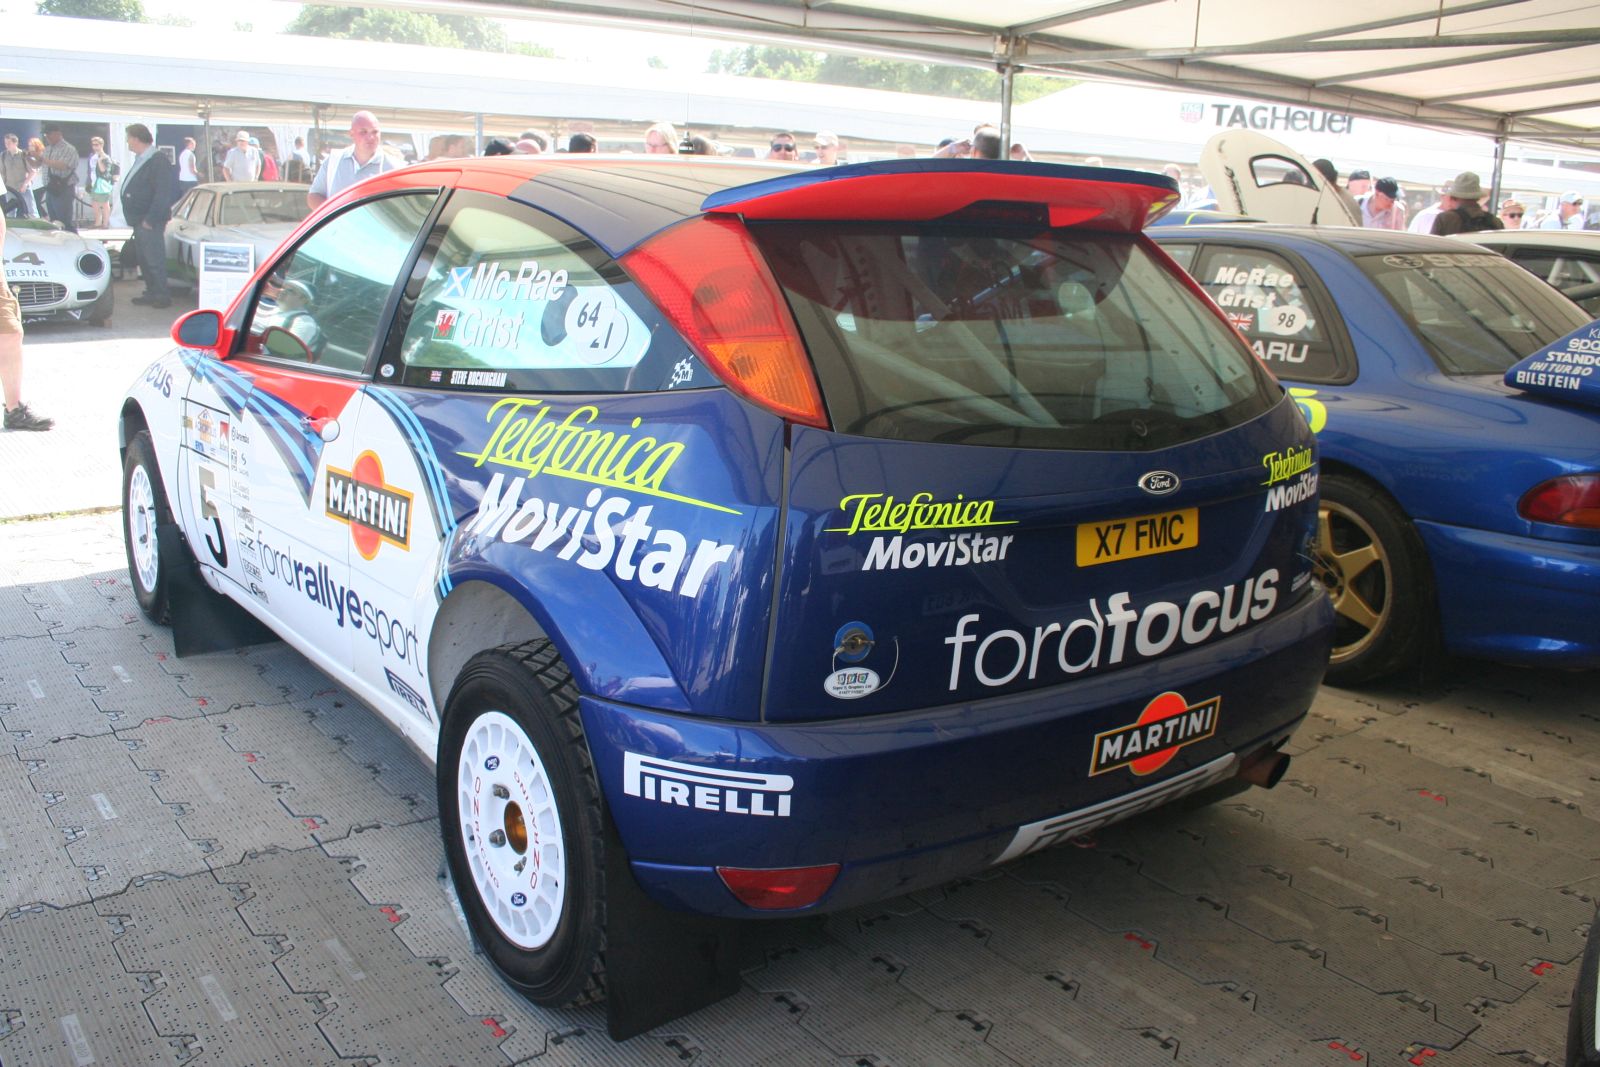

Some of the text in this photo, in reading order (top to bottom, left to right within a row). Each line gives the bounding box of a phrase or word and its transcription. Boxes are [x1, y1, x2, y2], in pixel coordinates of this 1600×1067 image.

[20, 269, 48, 277] STATE
[1214, 266, 1294, 287] McRae
[1218, 288, 1277, 308] Grist
[460, 307, 525, 350] Grist
[577, 301, 602, 329] 64
[1277, 312, 1296, 328] 98
[450, 370, 468, 385] STEVE
[1516, 370, 1580, 390] BILSTEIN
[1548, 363, 1593, 376] TURBO
[1150, 475, 1170, 490] Ford
[329, 476, 408, 538] MARTINI
[464, 472, 736, 598] MoviStar
[1094, 514, 1184, 559] X7 FMC
[861, 532, 1014, 571] MoviStar
[383, 666, 433, 724] PIRELLI
[1100, 704, 1214, 765] MARTINI
[622, 751, 795, 818] PIRELLI
